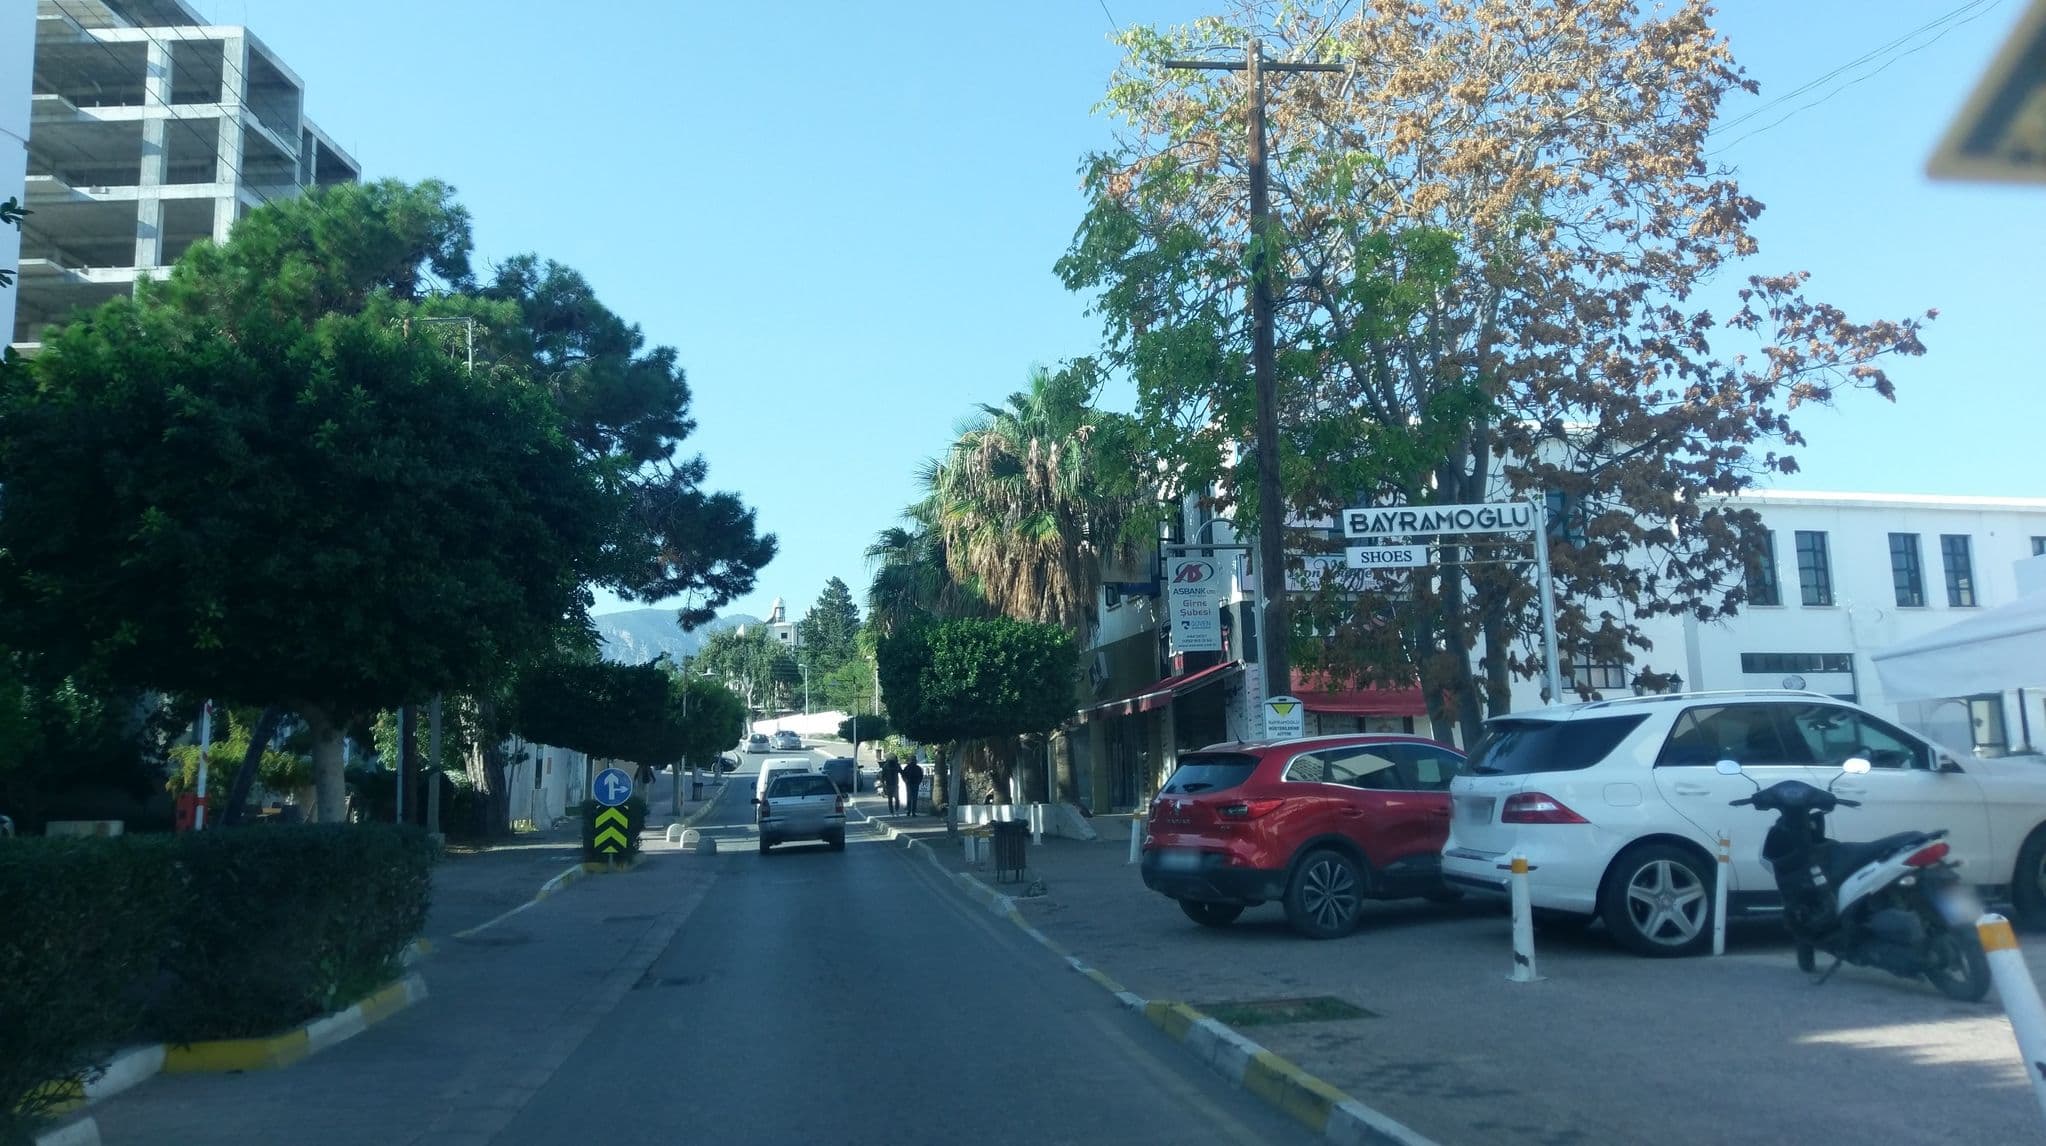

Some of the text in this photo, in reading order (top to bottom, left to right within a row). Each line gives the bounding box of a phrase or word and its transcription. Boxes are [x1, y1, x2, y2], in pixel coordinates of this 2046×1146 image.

[1349, 507, 1530, 533] BAYRAMOĞLU
[1360, 550, 1413, 564] SHOES
[1173, 587, 1206, 595] ASBANK
[1182, 599, 1208, 607] Girne
[1180, 608, 1211, 619] Şubesi
